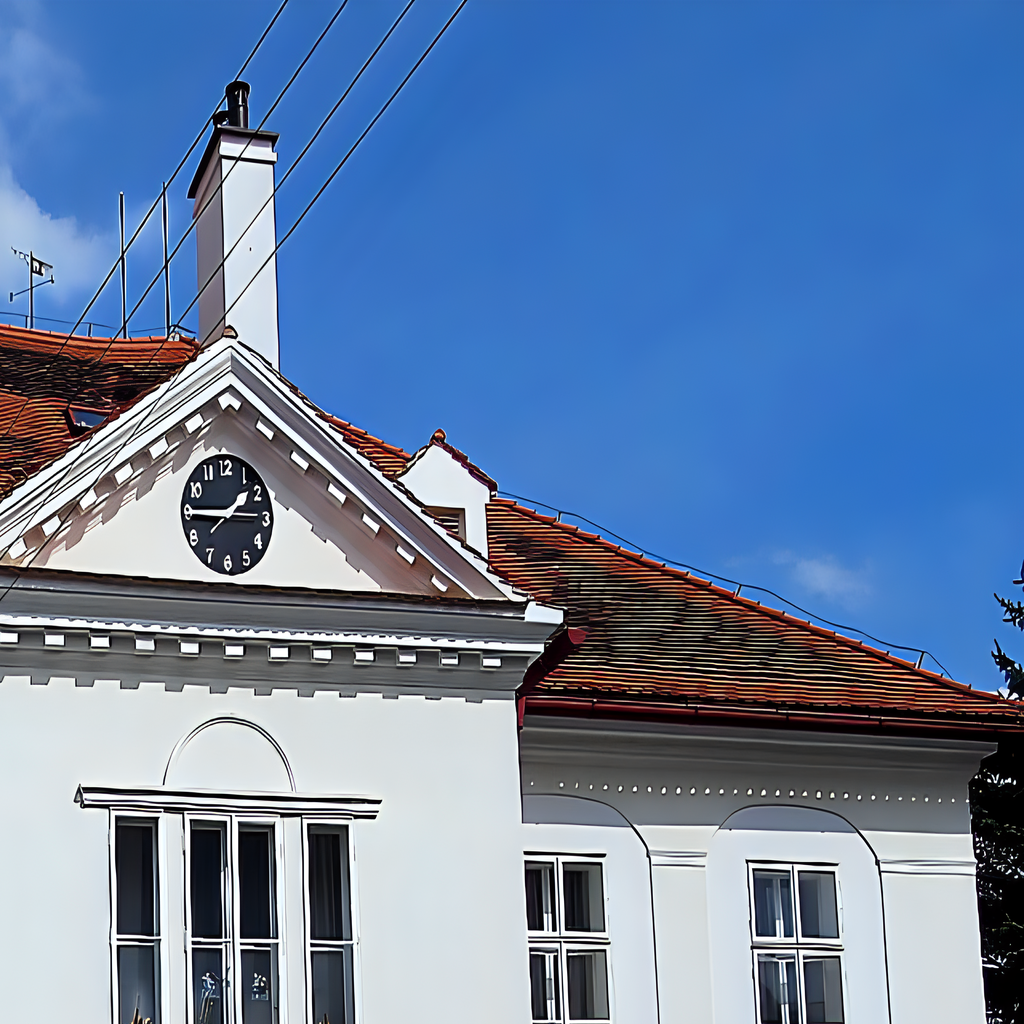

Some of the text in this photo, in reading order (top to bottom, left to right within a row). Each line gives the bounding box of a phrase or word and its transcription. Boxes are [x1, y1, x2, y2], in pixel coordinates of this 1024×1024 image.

[203, 464, 214, 481] 11
[219, 459, 233, 476] 12
[190, 481, 203, 498] 10
[253, 484, 262, 502] 2
[183, 503, 193, 520] 9
[261, 511, 271, 528] 3
[189, 528, 199, 547] 8
[253, 532, 263, 550] 4
[205, 547, 215, 564] 7
[223, 554, 233, 572] 6
[242, 550, 251, 567] 5
